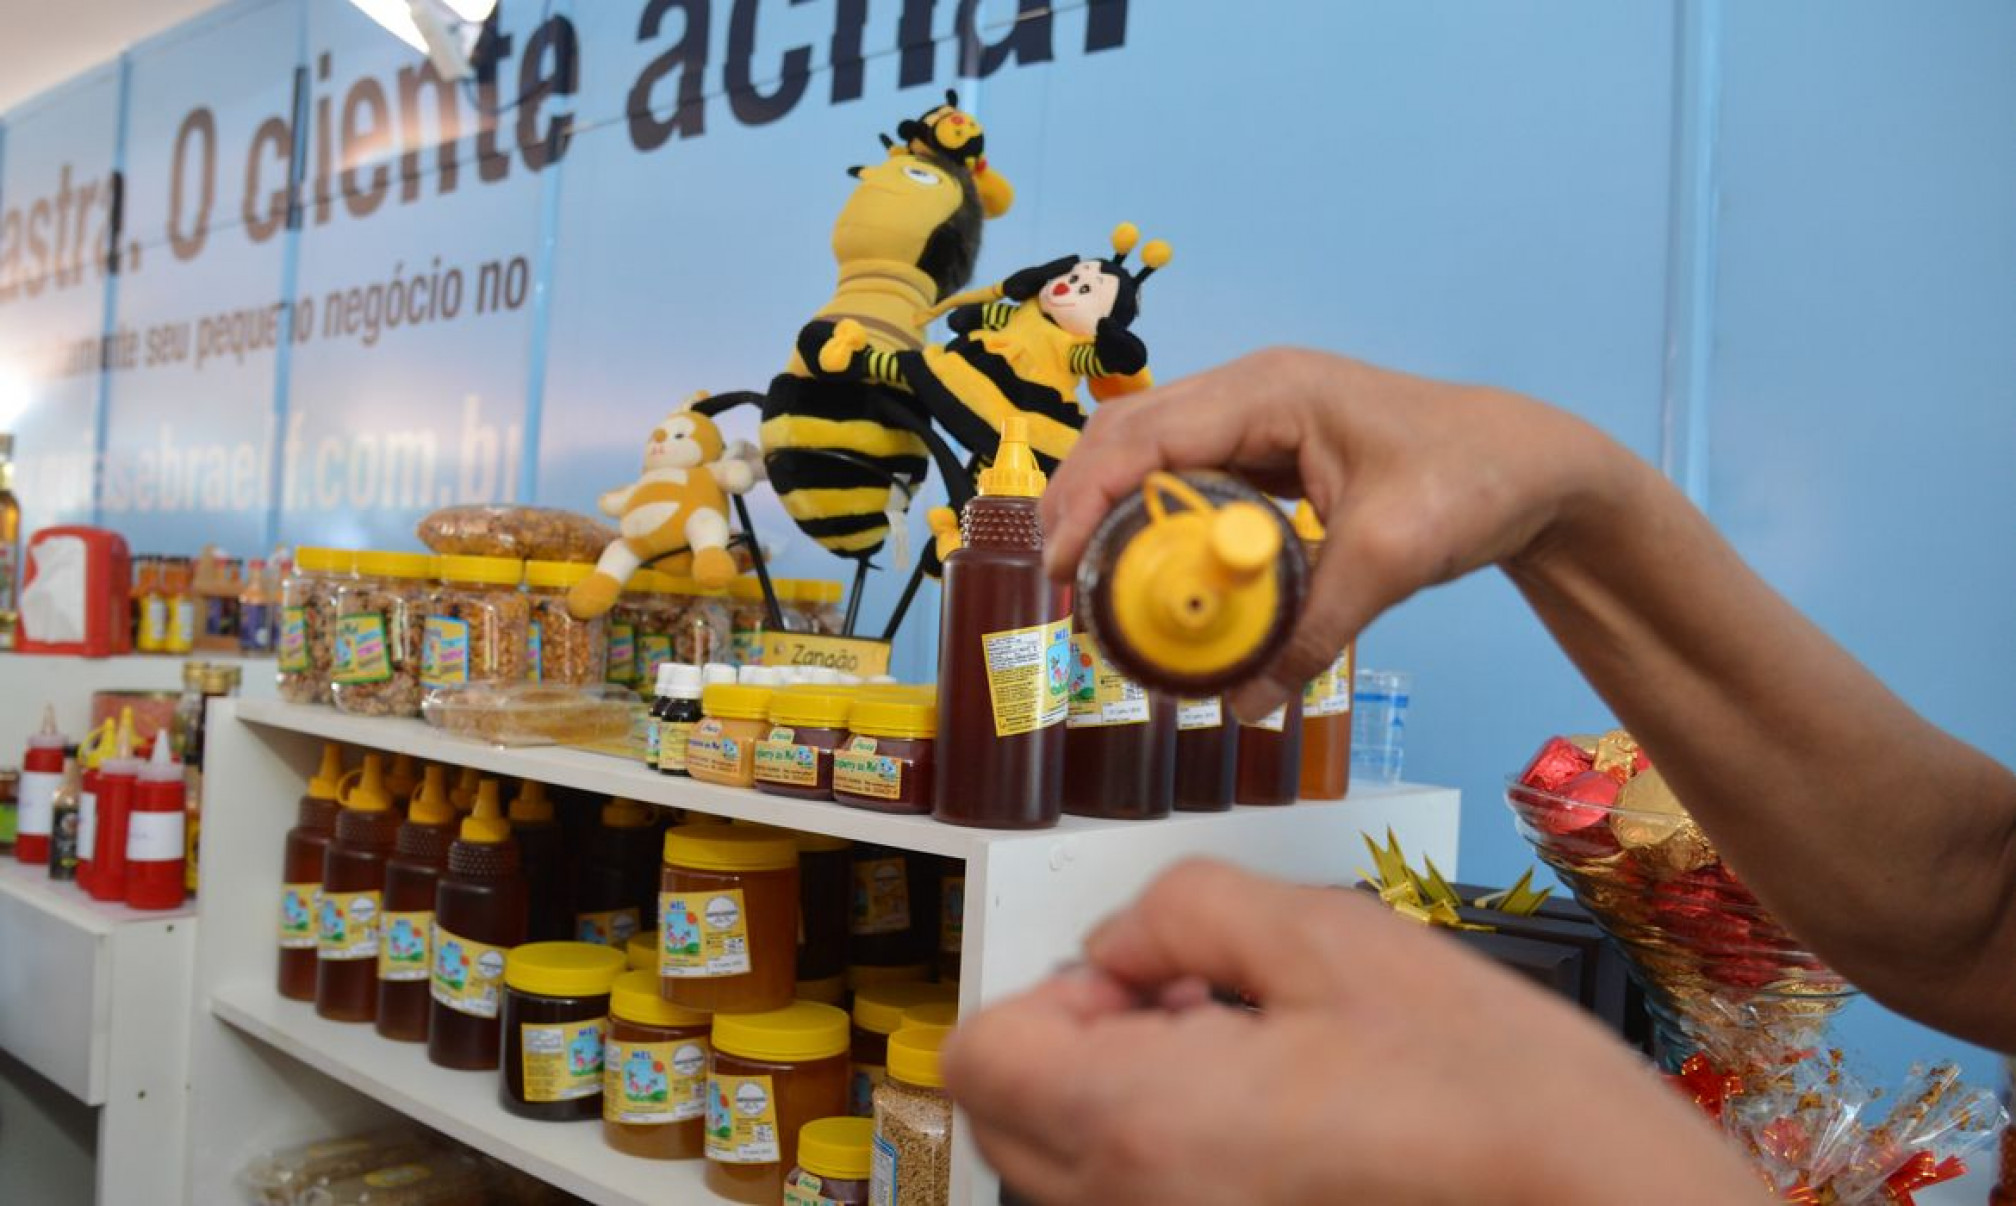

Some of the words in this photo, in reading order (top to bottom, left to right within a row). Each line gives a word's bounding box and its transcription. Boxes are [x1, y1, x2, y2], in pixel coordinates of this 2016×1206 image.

[168, 104, 217, 261] O
[144, 319, 191, 367] seu
[322, 256, 464, 347] negócio
[475, 256, 530, 316] no
